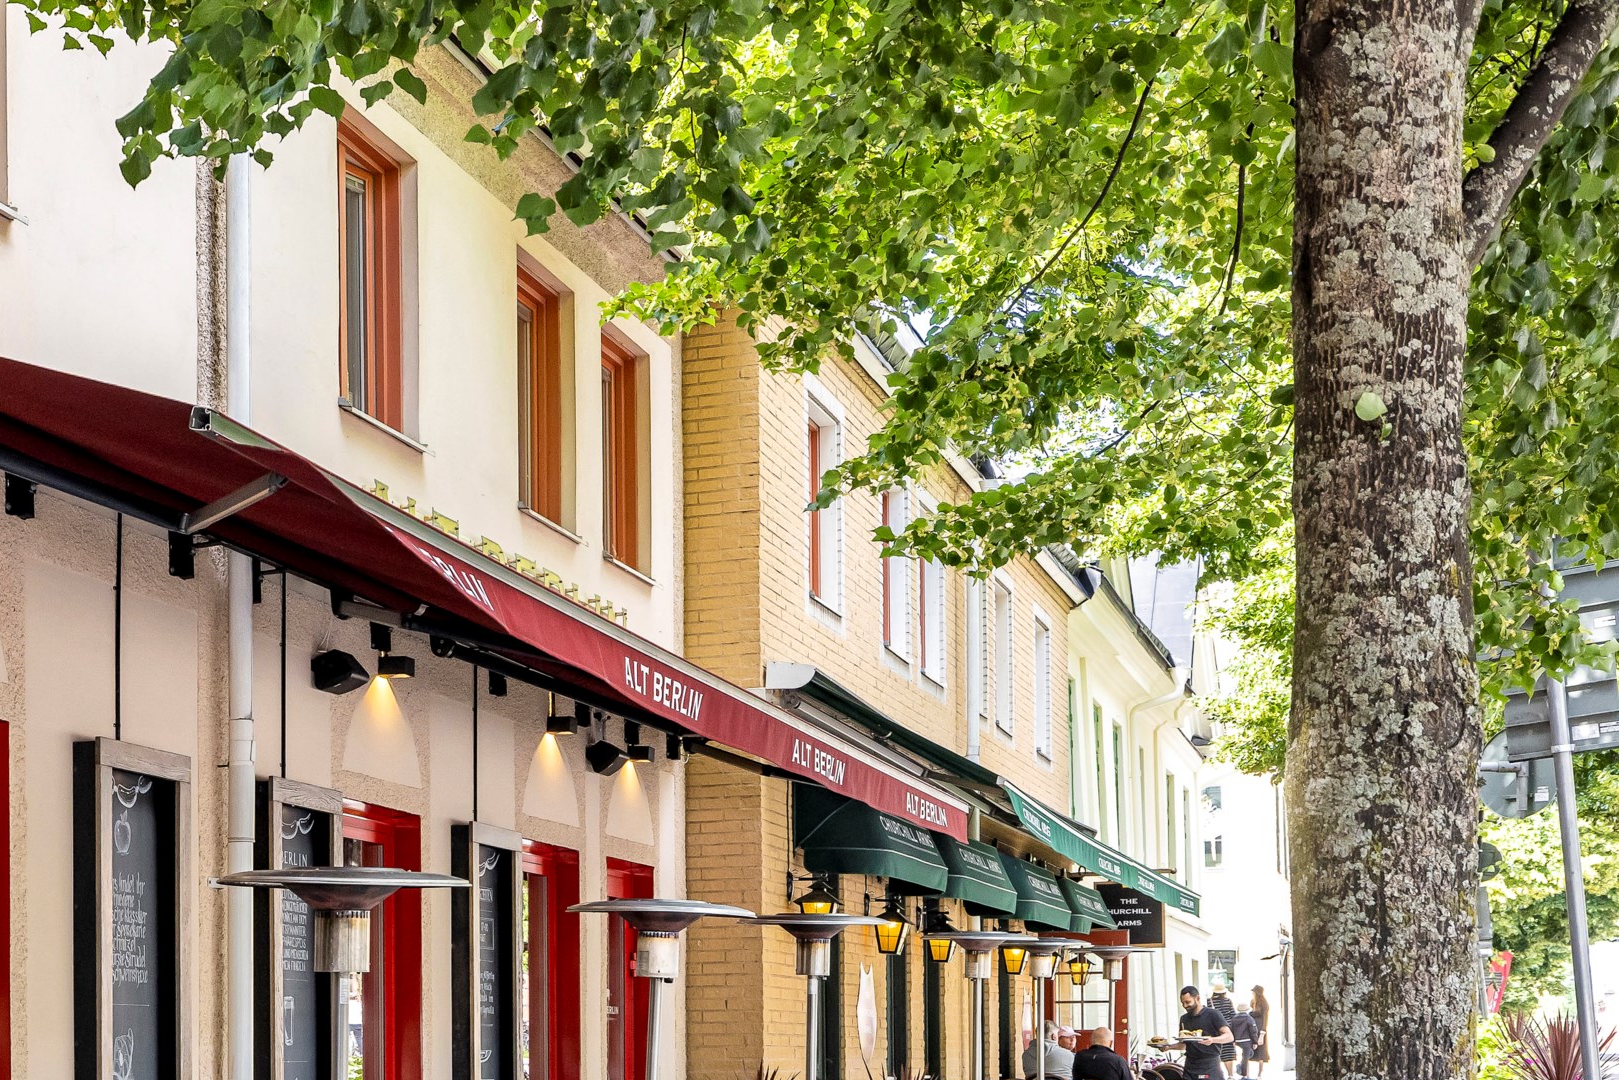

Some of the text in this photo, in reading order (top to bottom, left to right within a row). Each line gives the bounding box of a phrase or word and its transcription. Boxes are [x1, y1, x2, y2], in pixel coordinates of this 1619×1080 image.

[624, 657, 703, 722] ALT BERLIN
[792, 739, 846, 786] ALT BERLIN
[906, 792, 948, 828] ALT BERLIN
[879, 815, 935, 848] CHURCHILL ARMS
[959, 848, 1002, 875] CHURCHILL ARMS
